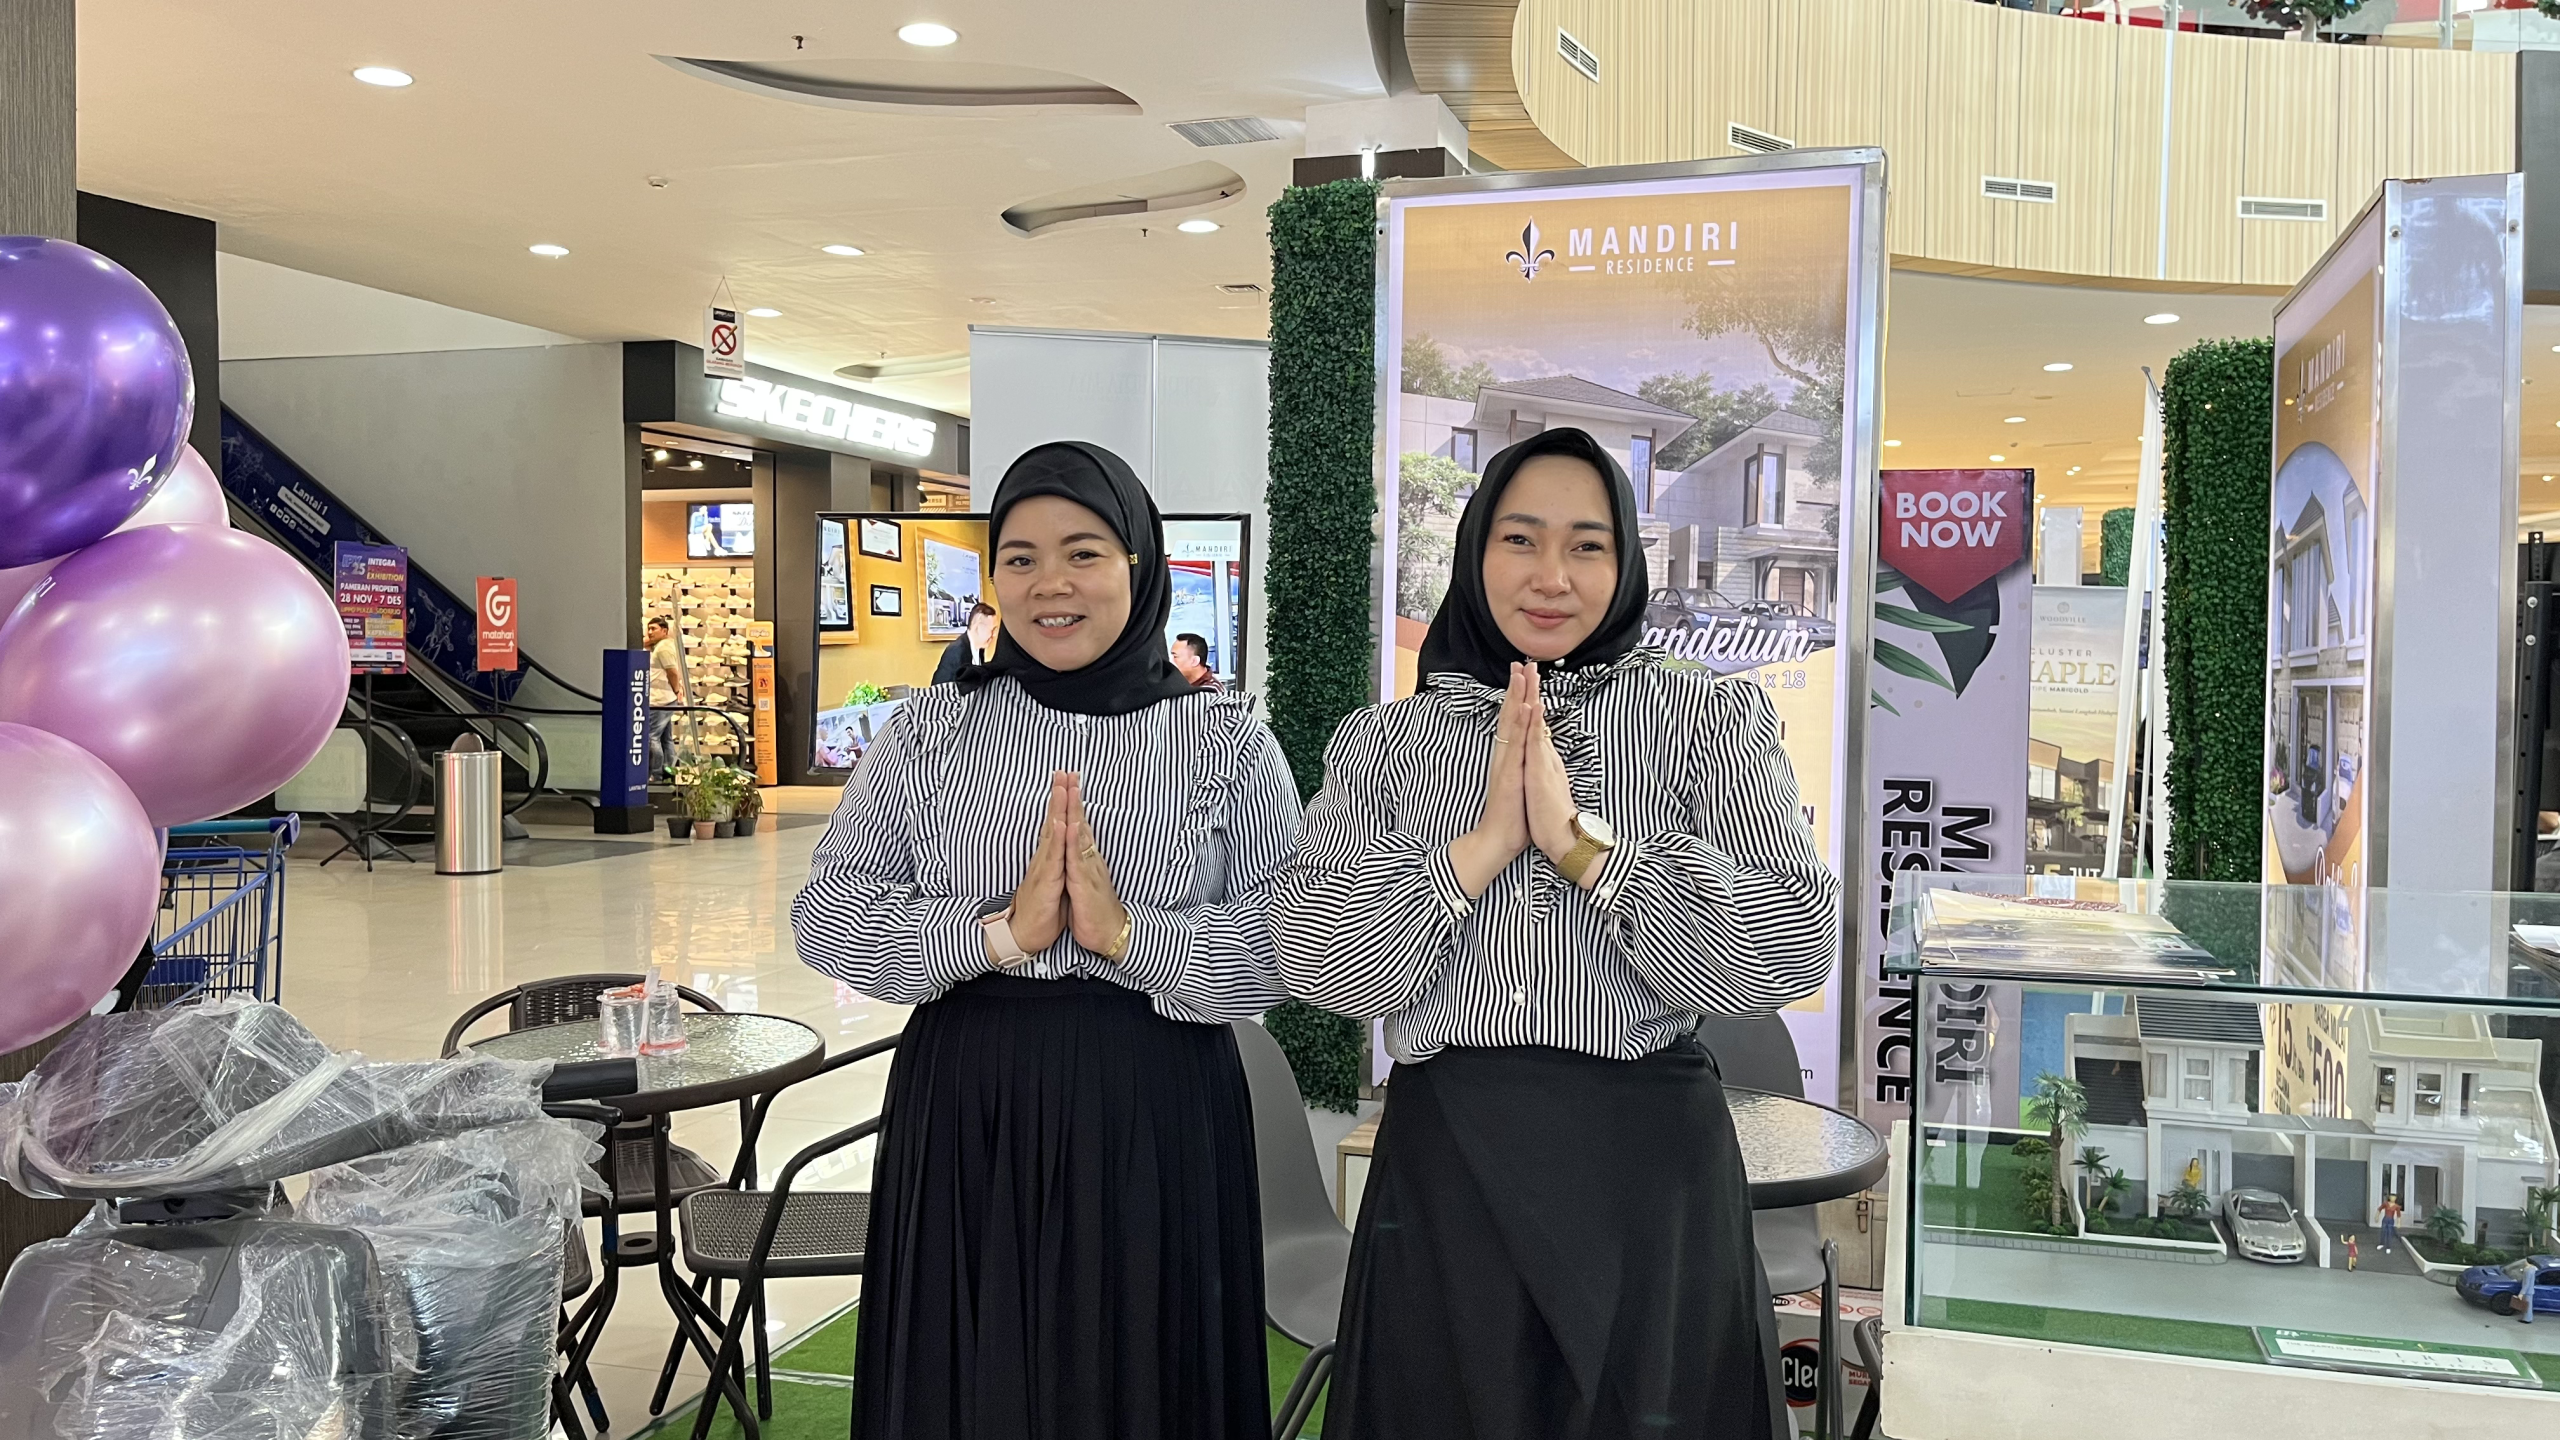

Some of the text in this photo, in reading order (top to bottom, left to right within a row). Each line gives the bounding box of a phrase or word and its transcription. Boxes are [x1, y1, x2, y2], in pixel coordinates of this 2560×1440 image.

[1568, 221, 1737, 257] MANDIRI
[1606, 257, 1694, 275] RESIDENCE
[2307, 330, 2346, 394] MANDIRI
[292, 482, 329, 516] Lantai 1
[1896, 490, 2007, 519] BOOK
[1901, 521, 2002, 549] NOW
[1195, 545, 1233, 553] MANDIRI
[351, 562, 366, 576] 25
[367, 557, 396, 567] INTEGRA
[366, 572, 405, 582] EXHIBITION
[340, 582, 399, 594] PAMERAN PROPERTI
[340, 593, 351, 603] 28
[353, 593, 373, 604] NOV
[379, 595, 386, 604] 7
[387, 595, 402, 605] DES
[482, 629, 515, 640] matahari
[1641, 615, 1815, 663] andelium
[1782, 670, 1806, 689] 18
[2049, 686, 2089, 694] MARIGOLD
[629, 669, 646, 766] cinepolis
[2069, 867, 2101, 878] JUT
[1874, 778, 1933, 1104] RESNCE
[1935, 806, 1992, 1086] MDIRI
[1848, 1371, 1871, 1379] MUR
